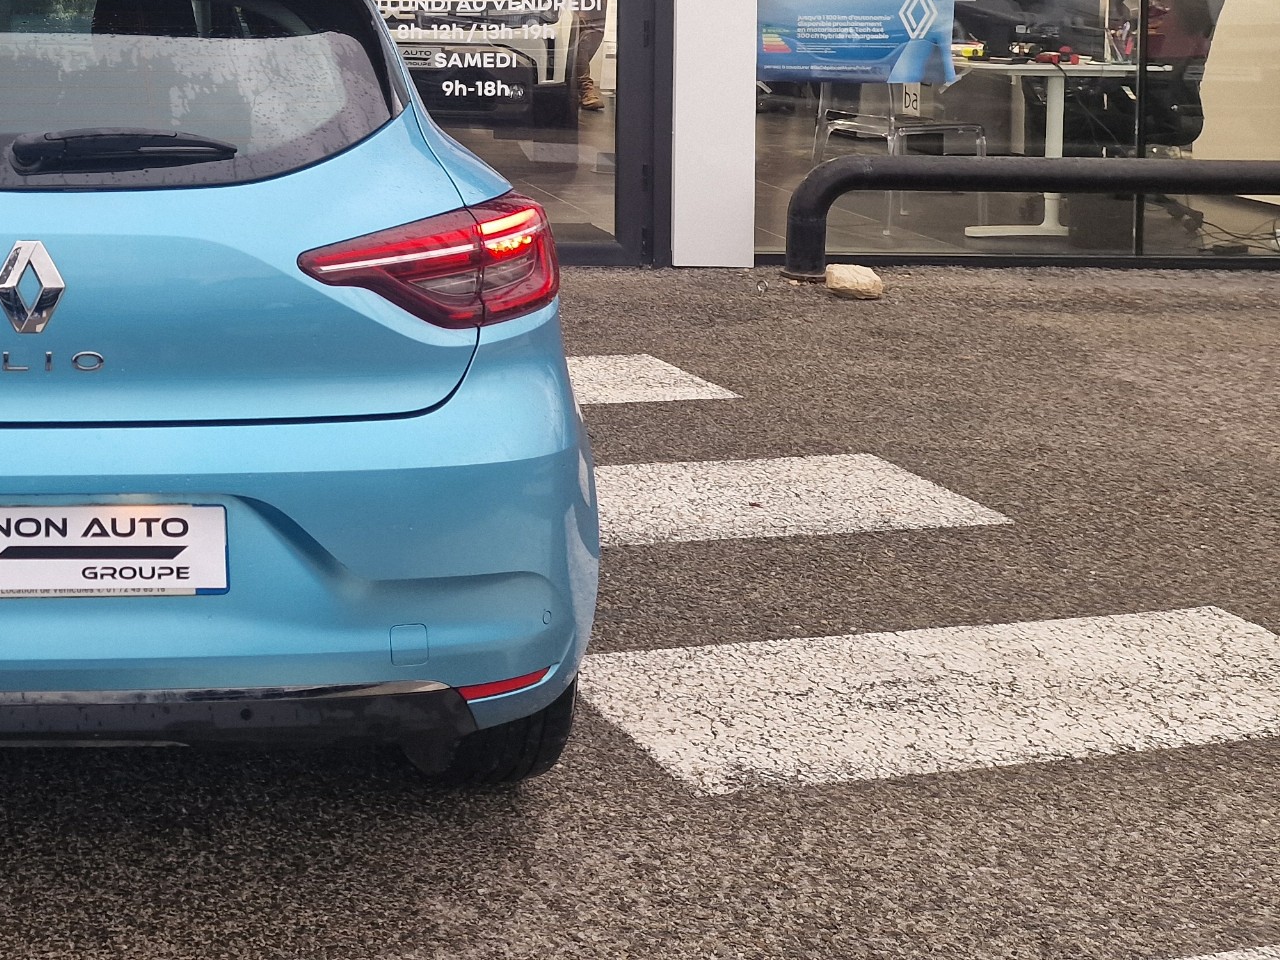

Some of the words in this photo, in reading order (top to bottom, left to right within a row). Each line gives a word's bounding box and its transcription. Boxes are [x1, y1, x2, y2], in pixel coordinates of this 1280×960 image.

[396, 23, 465, 40] 8h-12h
[480, 23, 556, 40] 13h-19h
[403, 49, 432, 57] AUTO
[434, 52, 518, 69] SAMEDI
[441, 79, 510, 97] 9h-18h
[81, 517, 190, 538] AUTO
[81, 566, 190, 580] GROUPE
